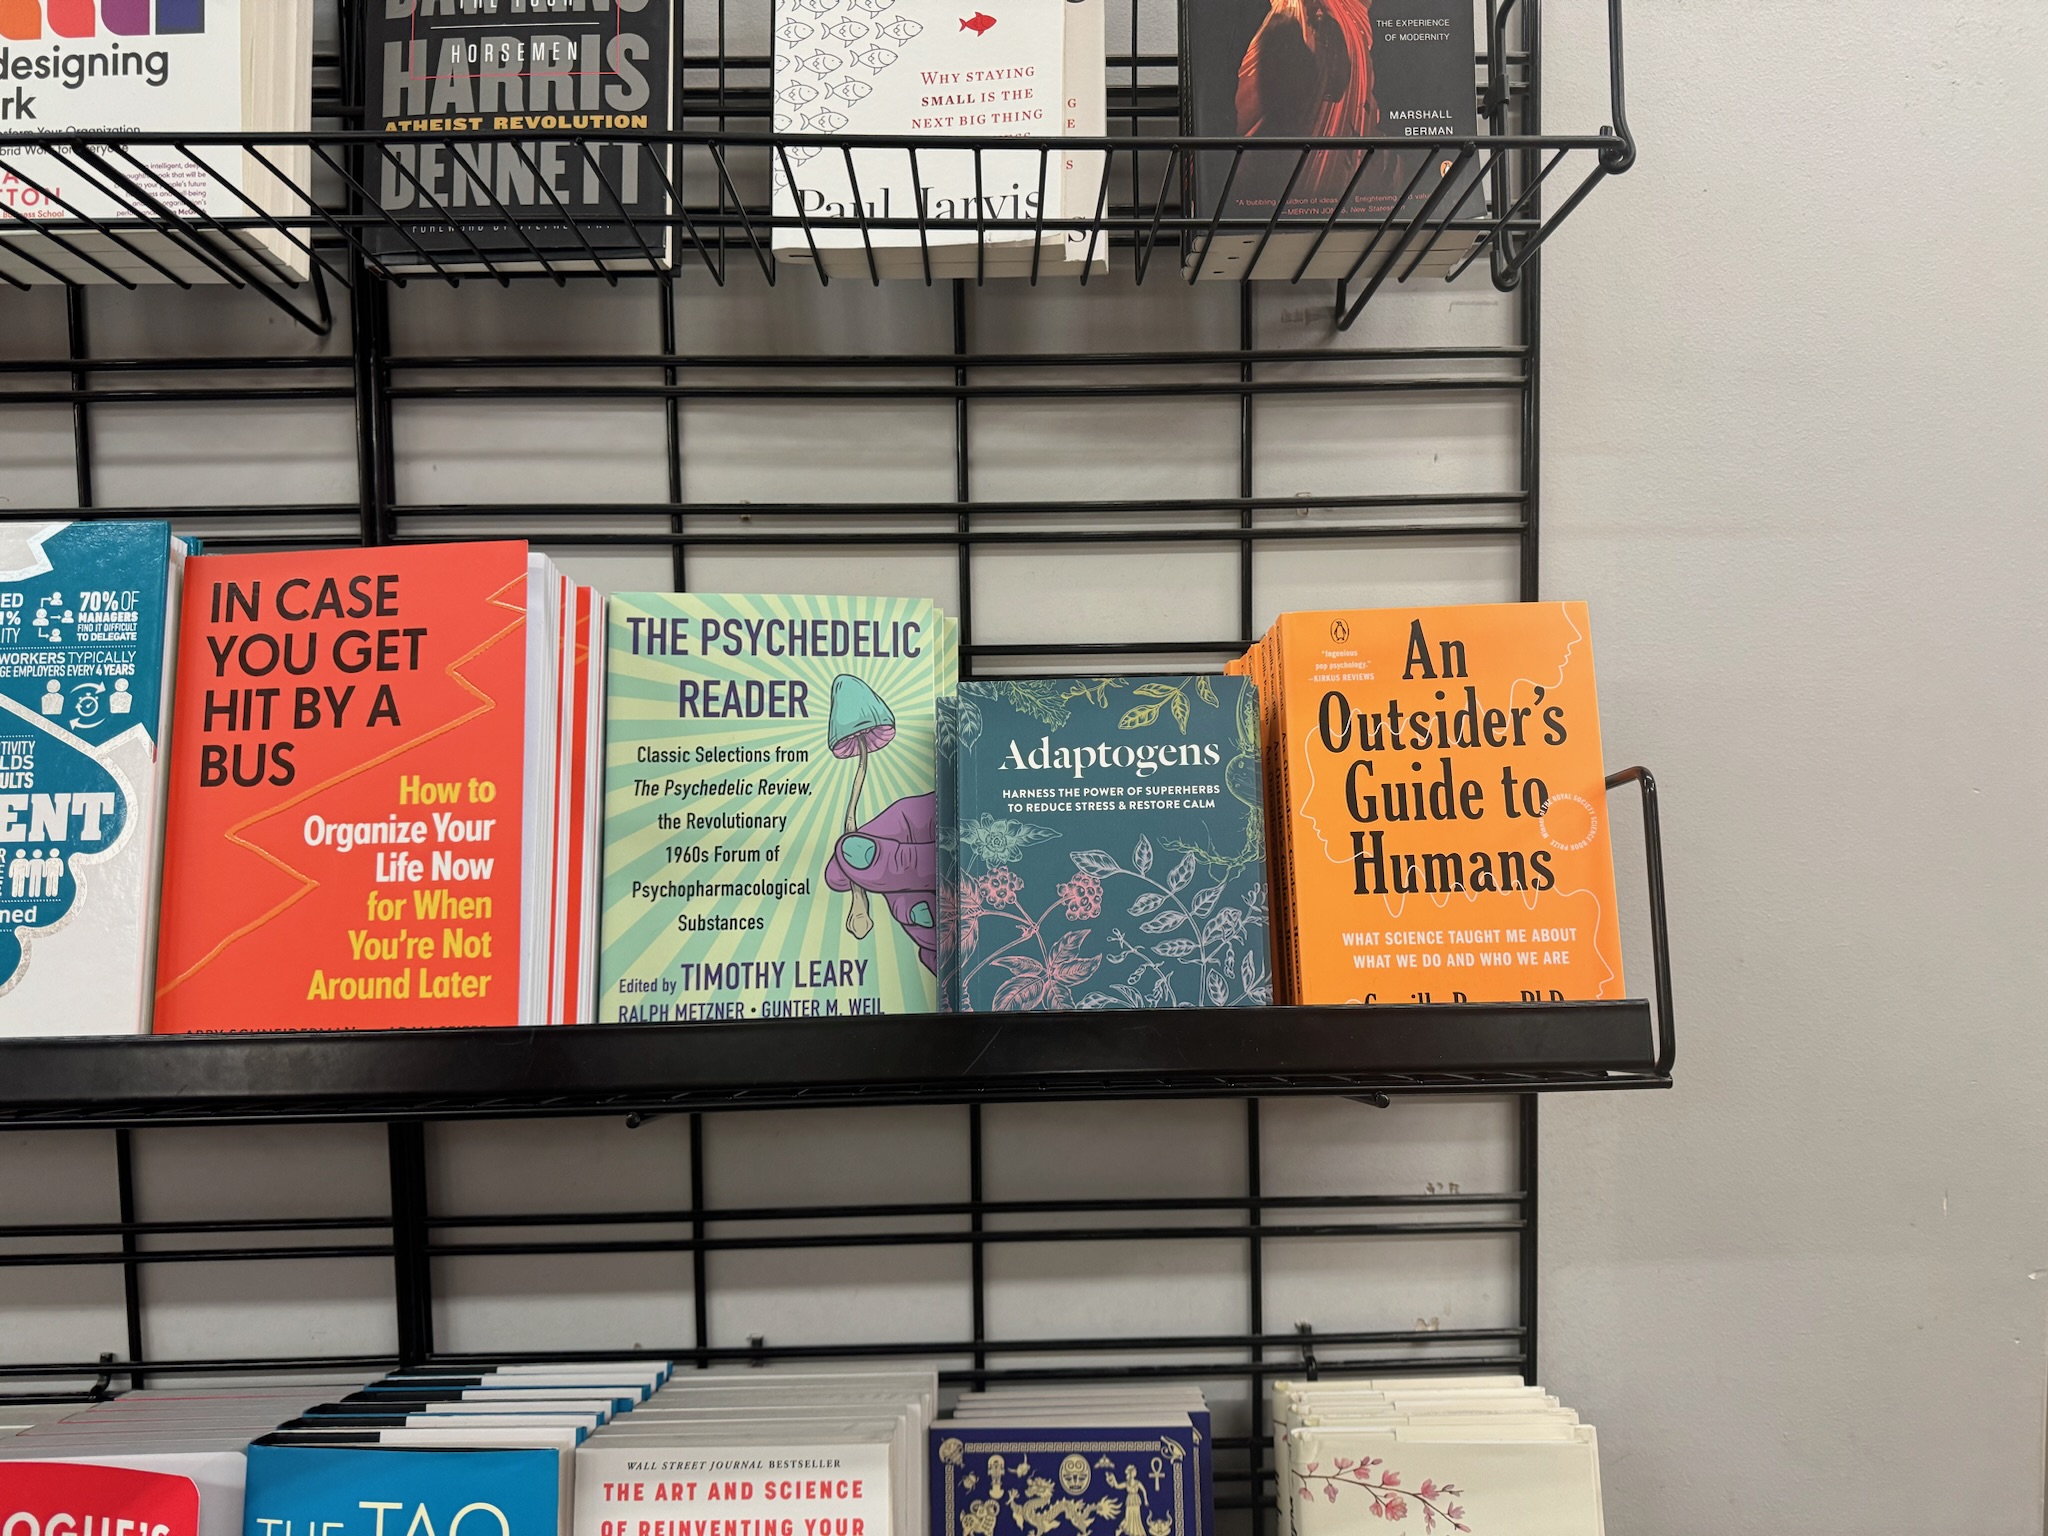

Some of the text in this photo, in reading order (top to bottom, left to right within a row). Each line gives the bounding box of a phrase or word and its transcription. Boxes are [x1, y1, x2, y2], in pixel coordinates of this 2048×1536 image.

[1376, 18, 1450, 28] THE EXPERIENCE
[1385, 32, 1450, 41] OF MODERNITY
[451, 42, 577, 63] HORSEMEN
[382, 33, 650, 117] HARRIS
[966, 66, 1035, 83] STAYING
[921, 88, 1034, 107] SMALL IS THE
[385, 115, 648, 132] ATHEIST REVOLUTION
[911, 109, 1043, 129] NEXT BIG THING
[1389, 109, 1453, 136] MARSHALL BERMAN
[150, 163, 182, 171] intelligent,
[380, 142, 648, 211] DENNETT
[37, 210, 64, 218] School
[80, 590, 140, 611] 70% OF
[210, 574, 399, 623] IN CASE
[78, 611, 138, 623] MANAGERS
[78, 622, 137, 632] FIND IT DIFFICULT
[77, 632, 137, 641] TO DELEGATE
[626, 617, 921, 658] THE PSYCHEDELIC
[0, 650, 136, 664] WORKERS TYPICALLY
[207, 628, 427, 677] YOU GET
[1402, 619, 1468, 680] An
[13, 665, 65, 678] EMPLOYERS
[67, 664, 95, 676] EVERY
[96, 664, 102, 676] 4
[104, 663, 135, 675] YEARS
[1315, 663, 1328, 671] pop
[1342, 673, 1375, 681] REVIEWS
[203, 684, 401, 731] HIT BY A
[679, 680, 809, 718] READER
[1319, 685, 1567, 753] Outsider's
[200, 741, 295, 787] BUS
[637, 745, 809, 763] Classic Selections from
[998, 736, 1220, 778] Adaptogens
[400, 775, 496, 805] How to
[634, 779, 660, 796] The
[664, 777, 753, 800] Psychedelic
[1002, 785, 1220, 798] HARNESS THE POWER OF SUPERHERBS
[1346, 757, 1549, 823] Guide to
[1552, 793, 1571, 802] ROYAL
[1008, 799, 1215, 813] TO REDUCE STRESS & RESTORE CALM
[1573, 794, 1595, 815] SOCIETY
[304, 812, 496, 852] Organize Your
[658, 812, 787, 833] the Revolutionary
[1586, 816, 1598, 842] SCIENCE
[665, 845, 780, 863] 1960s Forum of
[1550, 839, 1569, 851] PRIZE
[1570, 839, 1588, 851] BOOK
[375, 850, 494, 882] Life Now
[1350, 831, 1555, 895] Humans
[632, 878, 810, 902] Psychopharmacological
[367, 889, 491, 921] for When
[678, 914, 764, 931] Substances
[348, 928, 491, 960] You're Not
[1342, 928, 1577, 946] WHAT SCIENCE TAUGHT ME ABOUT
[1353, 951, 1570, 968] WHAT WE DO AND WHO WE ARE
[307, 967, 491, 1000] Around Later
[619, 959, 868, 995] Edited by TIMOTHY LEARY
[619, 998, 885, 1023] RALPH METZNER GUNTER M. WEIL
[627, 1459, 842, 1472] WALL STREET JOURNAL BESTSELLER
[603, 1480, 863, 1501] THE ART AND SCIENCE
[601, 1518, 864, 1536] OF REINVENTING YOUR
